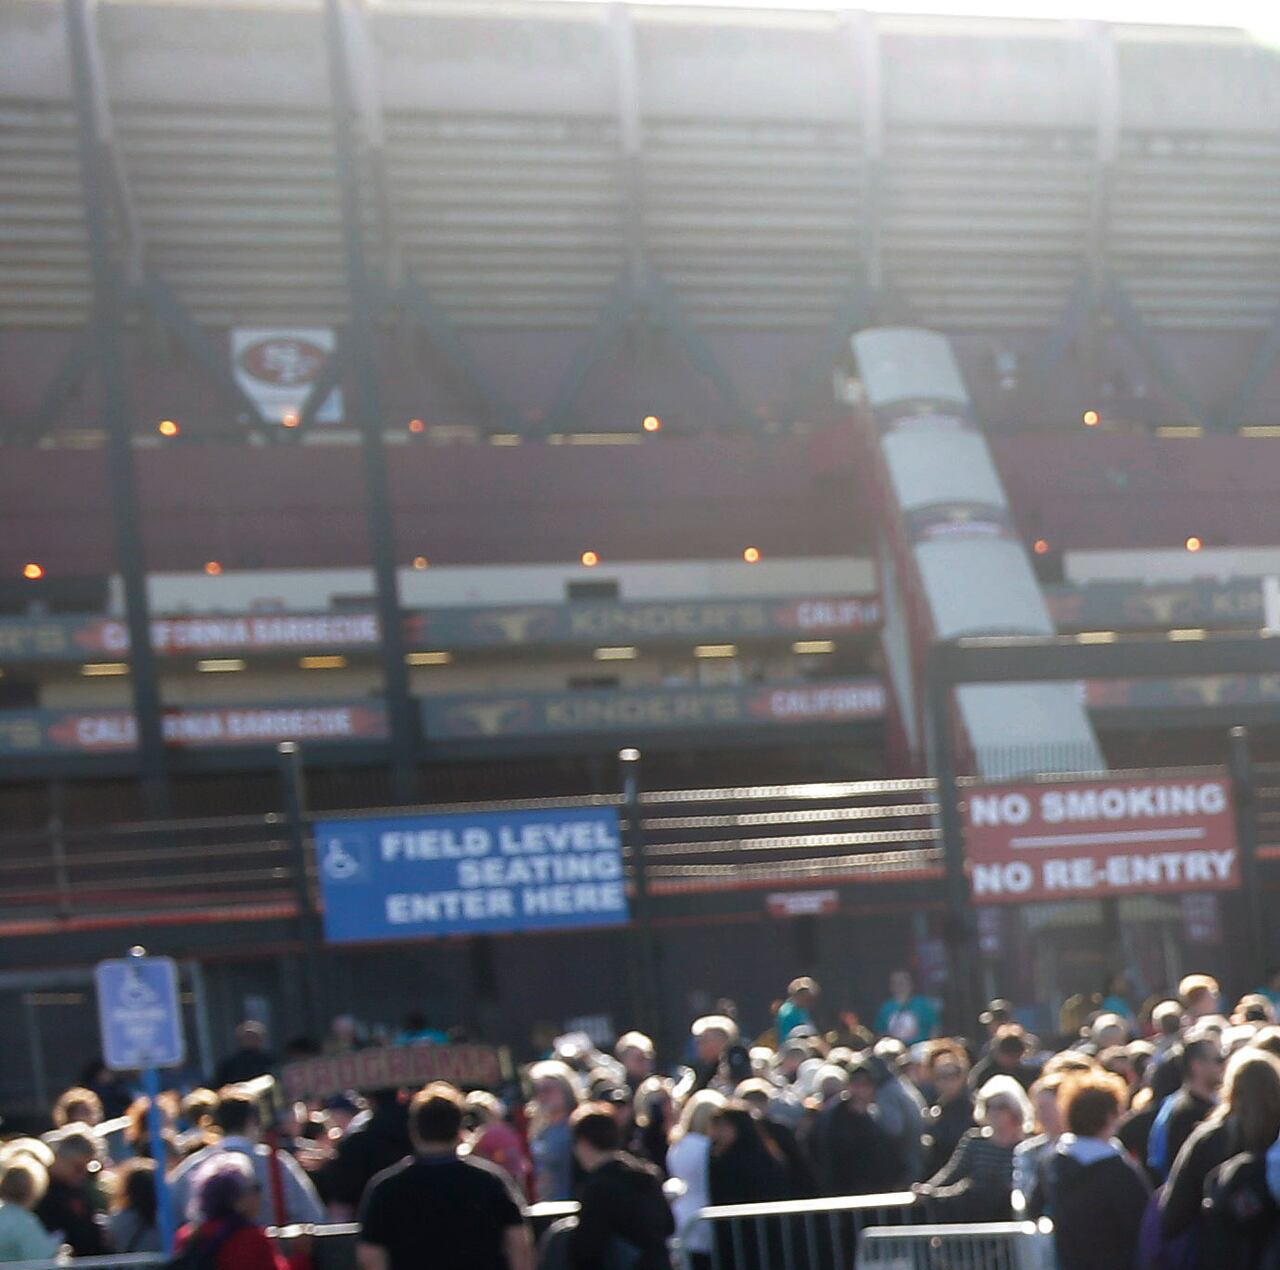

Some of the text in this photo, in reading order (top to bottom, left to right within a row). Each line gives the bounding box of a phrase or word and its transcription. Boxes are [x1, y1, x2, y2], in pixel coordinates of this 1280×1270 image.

[969, 782, 1227, 827] NO SMOKING
[380, 818, 618, 862] FIELD LEVEL
[457, 849, 623, 889] SEATING
[972, 848, 1236, 896] NO RE-ENTRY
[385, 880, 625, 925] ENTER HERE
